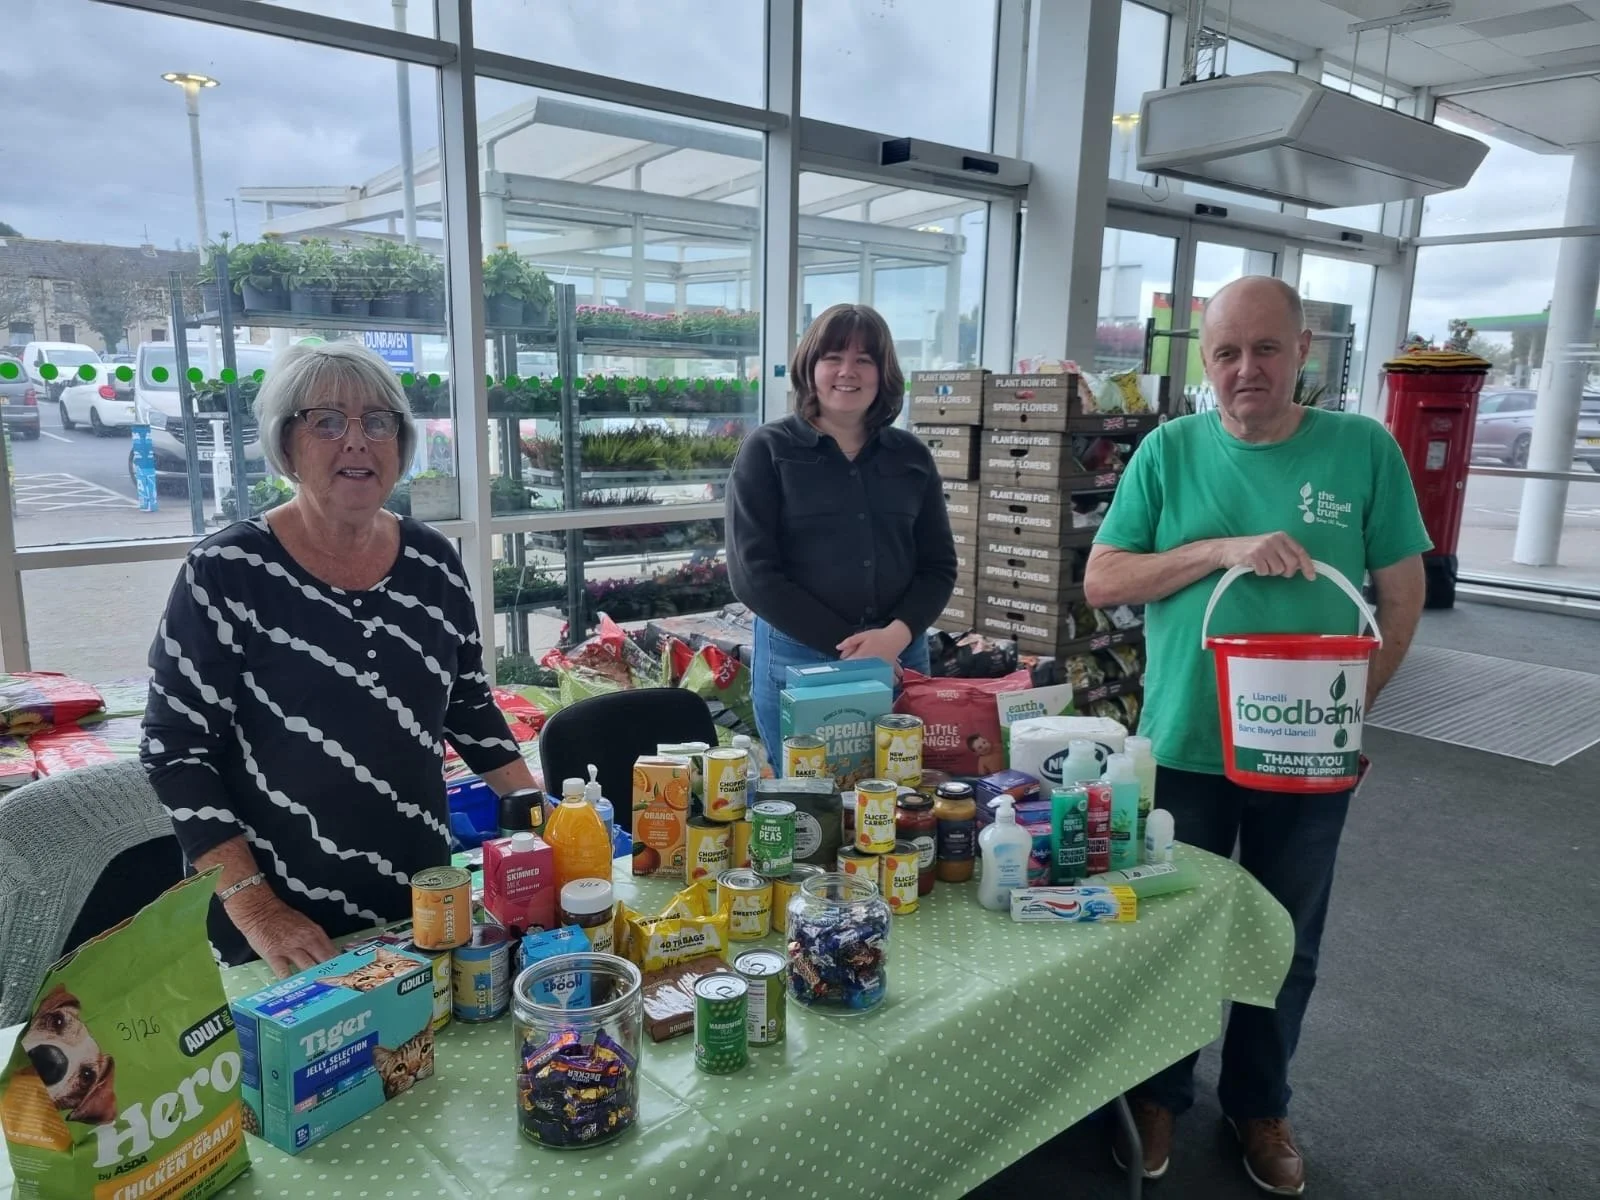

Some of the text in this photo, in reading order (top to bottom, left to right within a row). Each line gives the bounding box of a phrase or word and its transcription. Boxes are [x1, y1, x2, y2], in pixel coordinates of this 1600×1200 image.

[365, 331, 408, 349] DUNRAVEN
[918, 373, 939, 381] PLANT
[939, 373, 955, 381] NOW
[996, 379, 1056, 387] PLANT NOW FOR
[915, 396, 972, 404] SPRING FLOWERS
[993, 403, 1058, 412] SPRING FLOWERS
[912, 426, 960, 436] PLANT NOW FOR
[991, 436, 1050, 445] PLANT NOW FOR
[989, 459, 1051, 470] SPRING FLOWERS
[954, 482, 968, 490] FOR
[990, 490, 1050, 503] PLANT NOW FOR
[1318, 491, 1335, 501] the
[1317, 500, 1352, 512] trussell
[987, 513, 1051, 527] SPRING FLOWERS
[1317, 508, 1339, 519] trust
[989, 544, 1049, 559] PLANT NOW FOR
[986, 566, 1050, 583] SPRING FLOWERS
[953, 587, 964, 595] OR
[987, 596, 1048, 613] PLANT NOW FOR
[985, 618, 1048, 637] SPRING FLOWERS
[1252, 692, 1287, 703] Llanelli
[1008, 700, 1038, 714] earth
[1236, 695, 1362, 725] foodbank
[815, 720, 873, 740] SPECIAL
[923, 724, 958, 736] LITTLE
[1238, 724, 1317, 737] Banc Bwyd Llanelli
[826, 737, 871, 757] LAKES
[921, 735, 960, 748] ANGELS
[1262, 753, 1344, 767] THANK YOU
[1257, 764, 1346, 776] FOR YOUR SUPPORT
[644, 811, 675, 821] ORANGE
[760, 824, 781, 832] GARDEN
[759, 831, 782, 842] PEAS
[506, 868, 540, 881] SKIMMED
[659, 941, 671, 949] 40
[400, 972, 425, 994] ADULT
[116, 1016, 161, 1043] 3/26
[184, 1014, 224, 1053] ADULT
[300, 1010, 372, 1057] Tiger
[306, 1060, 327, 1078] JELLY
[329, 1040, 368, 1066] SELECTION
[324, 1064, 339, 1075] WITH
[88, 1051, 241, 1168] Hero
[113, 1153, 187, 1200] CHICKEN
[192, 1117, 235, 1160] GRAVY
[98, 1155, 149, 1181] by ASDA
